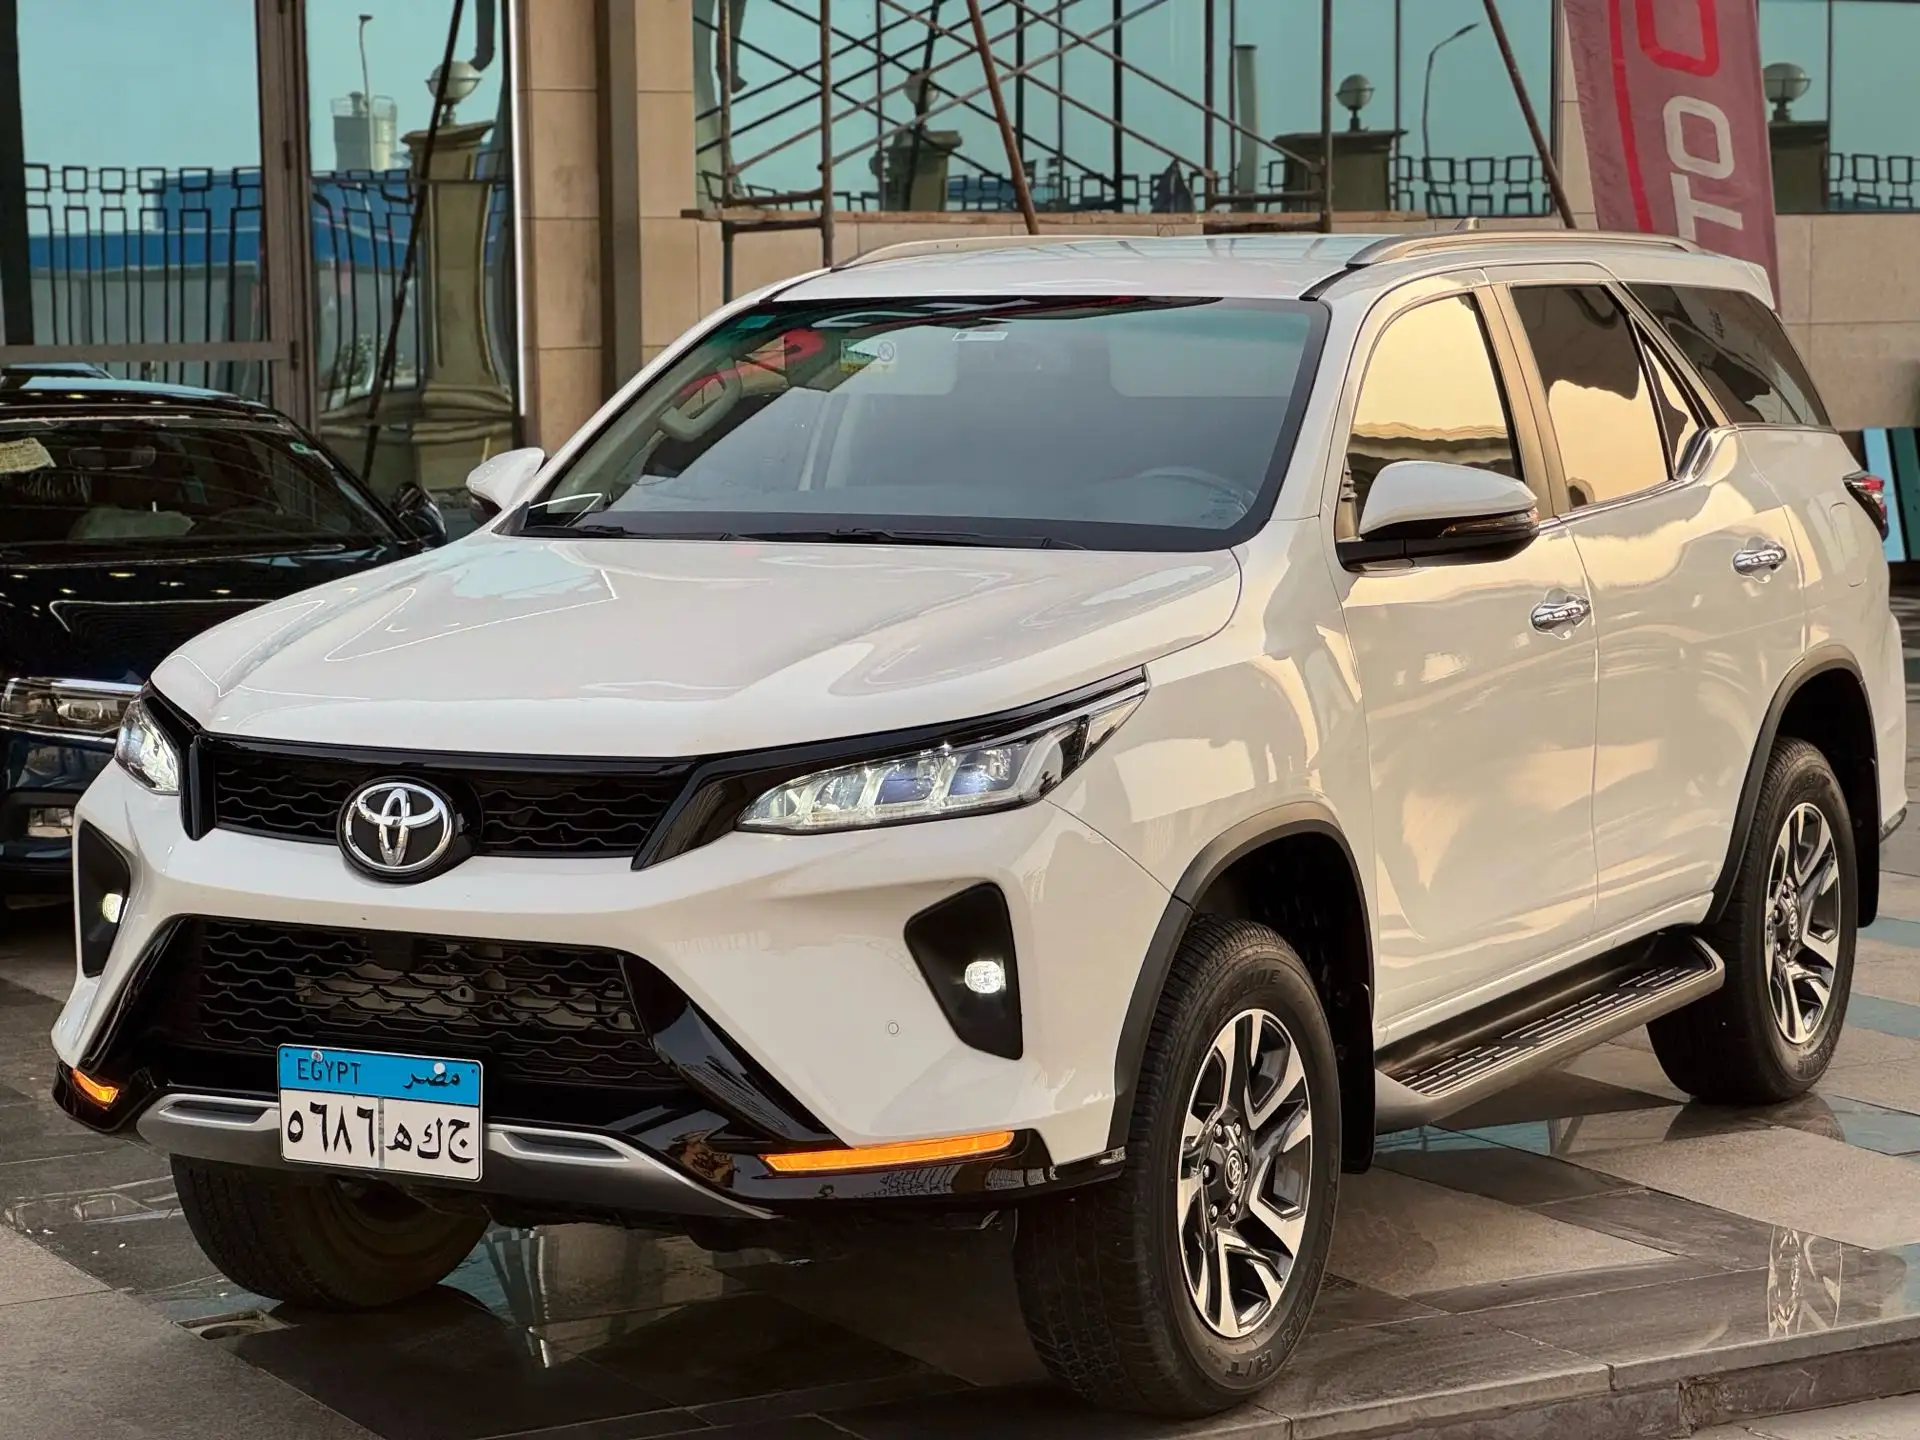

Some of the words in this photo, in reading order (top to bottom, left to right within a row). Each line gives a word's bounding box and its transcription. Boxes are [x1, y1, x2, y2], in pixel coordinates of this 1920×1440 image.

[297, 1057, 361, 1085] EGYPT
[403, 1071, 461, 1089] مصر
[287, 1101, 375, 1158] ٥٦٨٦
